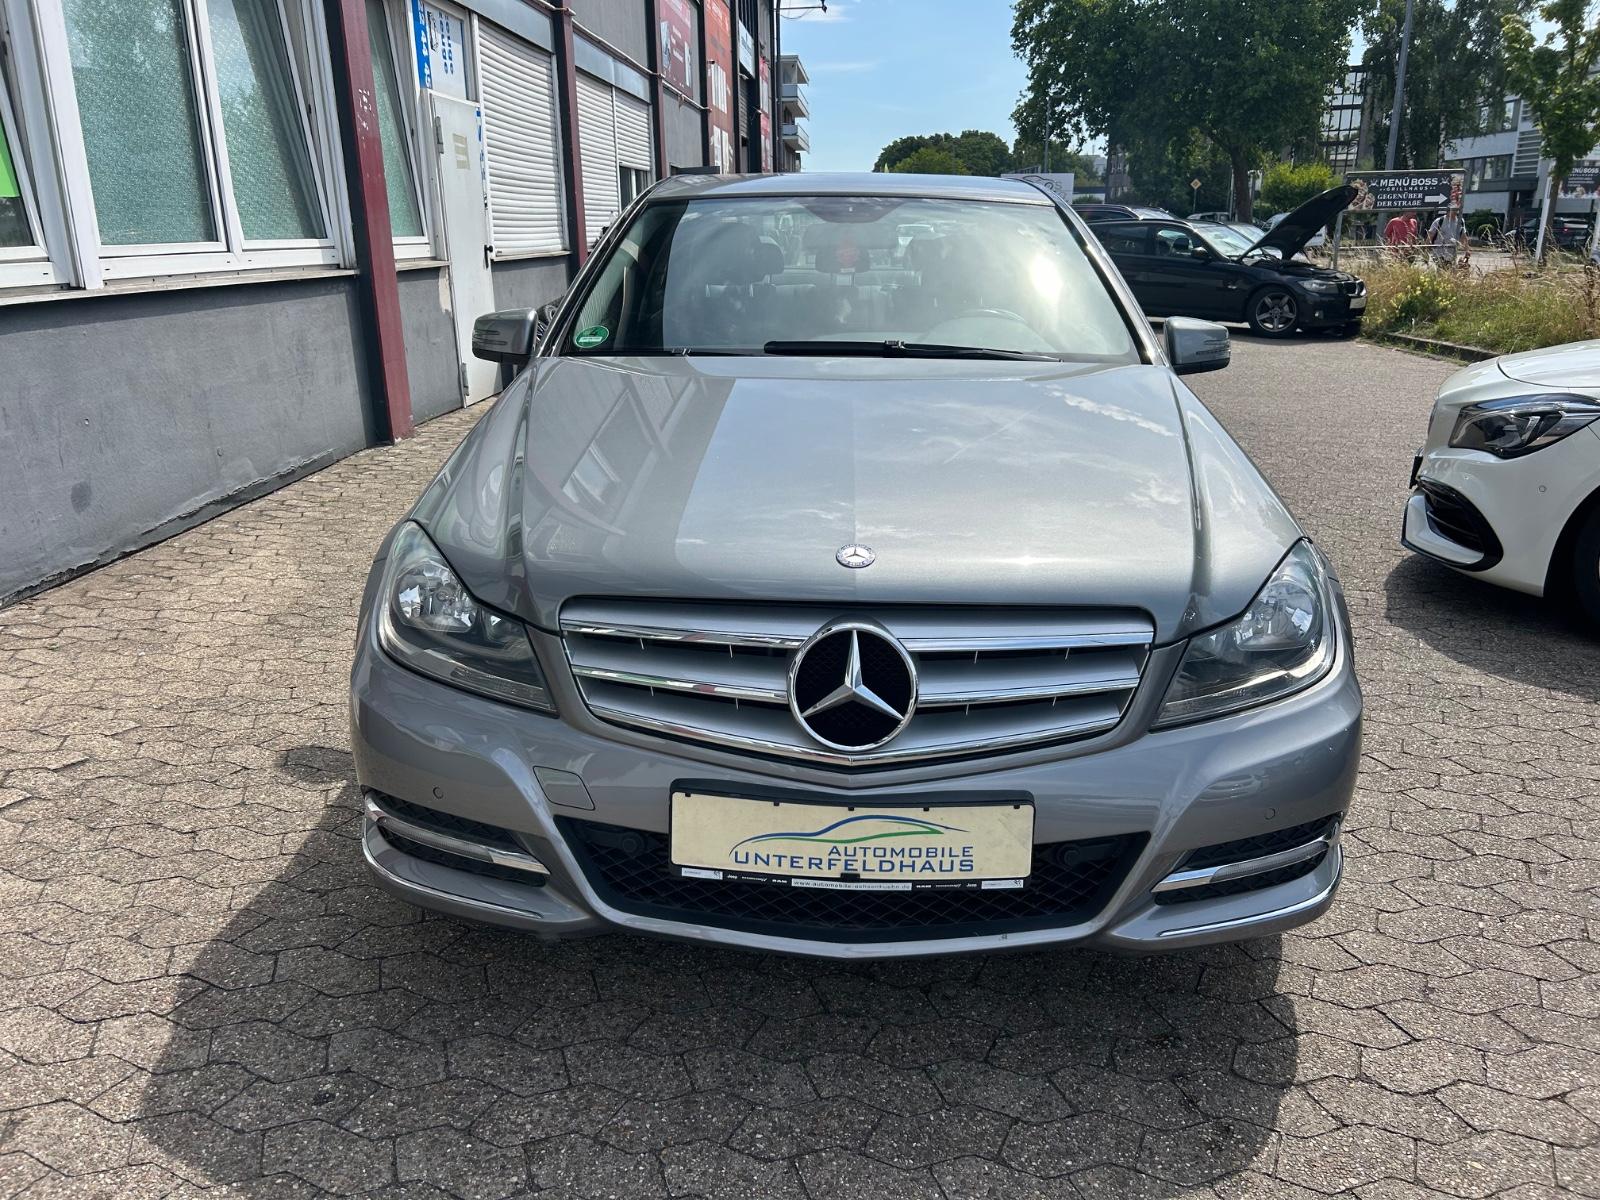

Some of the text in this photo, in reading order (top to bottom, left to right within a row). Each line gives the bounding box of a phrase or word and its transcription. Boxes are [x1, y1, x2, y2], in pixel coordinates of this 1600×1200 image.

[1379, 177, 1438, 187] MENÜ BOSS
[1377, 192, 1423, 200] GEGENÜBER
[828, 845, 974, 859] AUTOMOBILE
[734, 850, 974, 873] UNTERFELDHAUS
